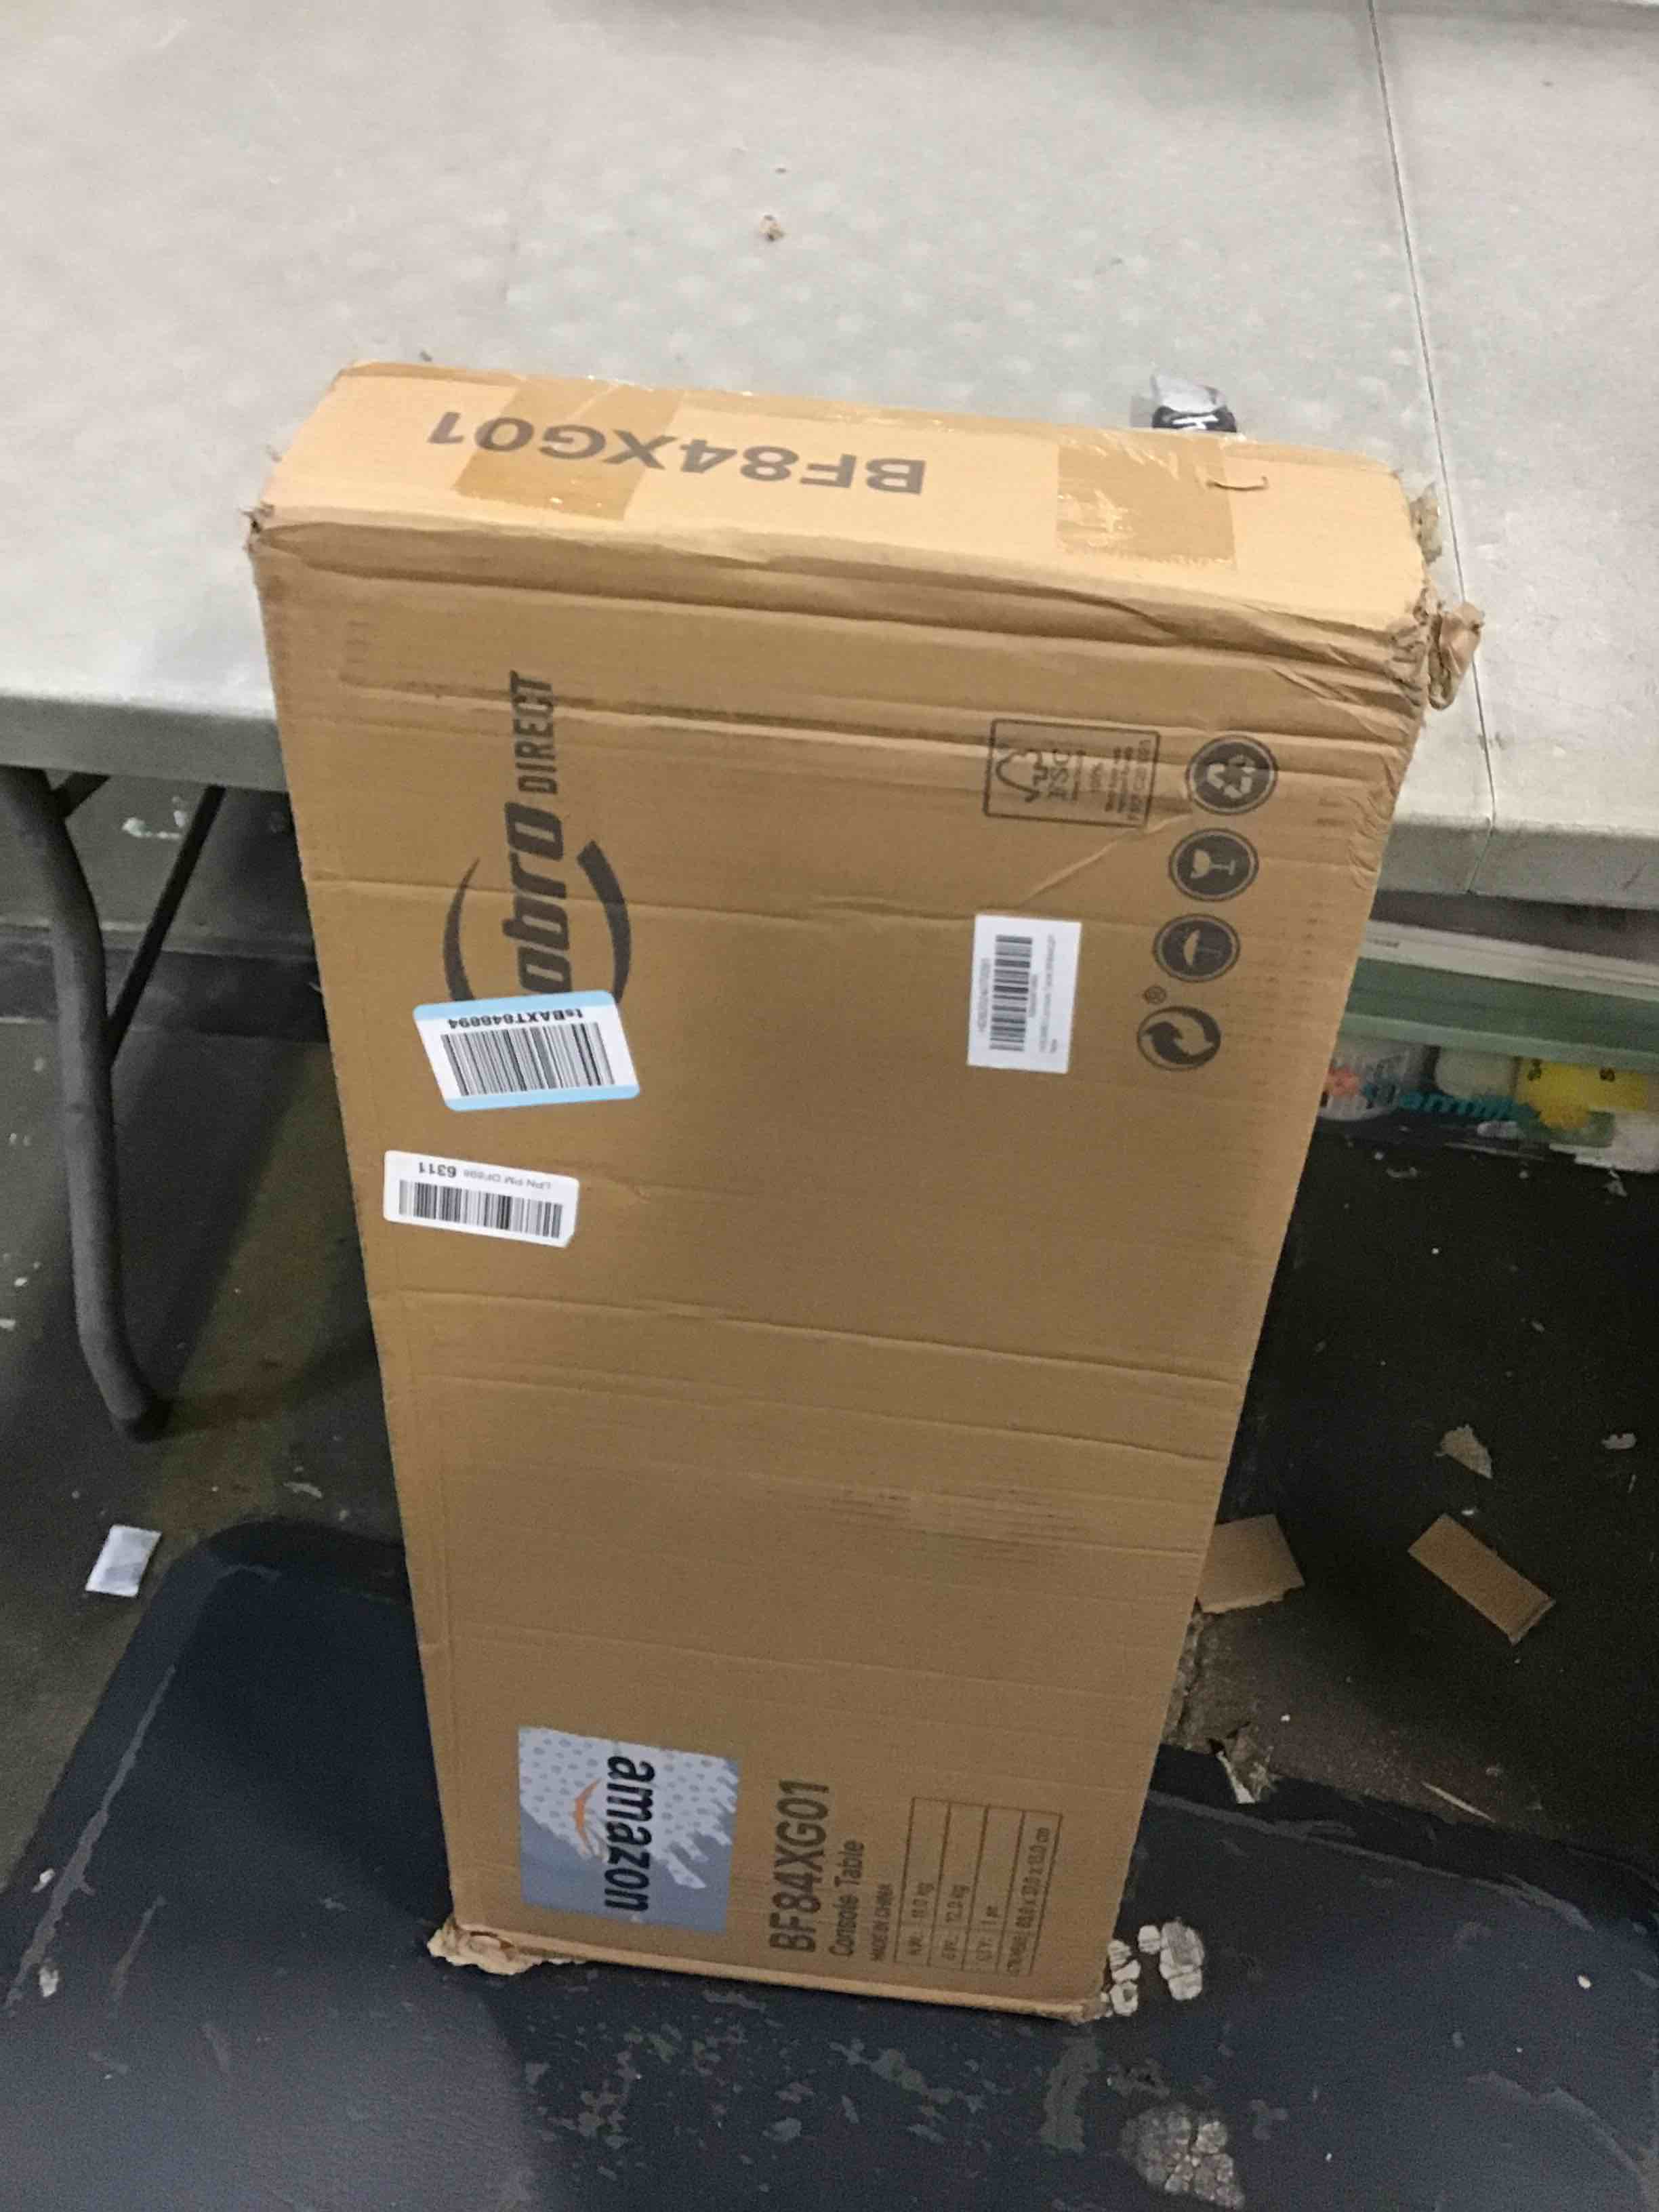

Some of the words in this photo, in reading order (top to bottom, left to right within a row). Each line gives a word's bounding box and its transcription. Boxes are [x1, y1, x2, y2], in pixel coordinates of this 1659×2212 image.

[426, 411, 926, 495] BF84XG01
[509, 670, 558, 794] DIRECT
[418, 1161, 457, 1179] 6311
[526, 1177, 551, 1191] LPN
[604, 1755, 655, 1912] amazon
[769, 1779, 830, 1953] BF84XG01
[834, 1839, 864, 1887] Table
[829, 1894, 859, 1957] Console
